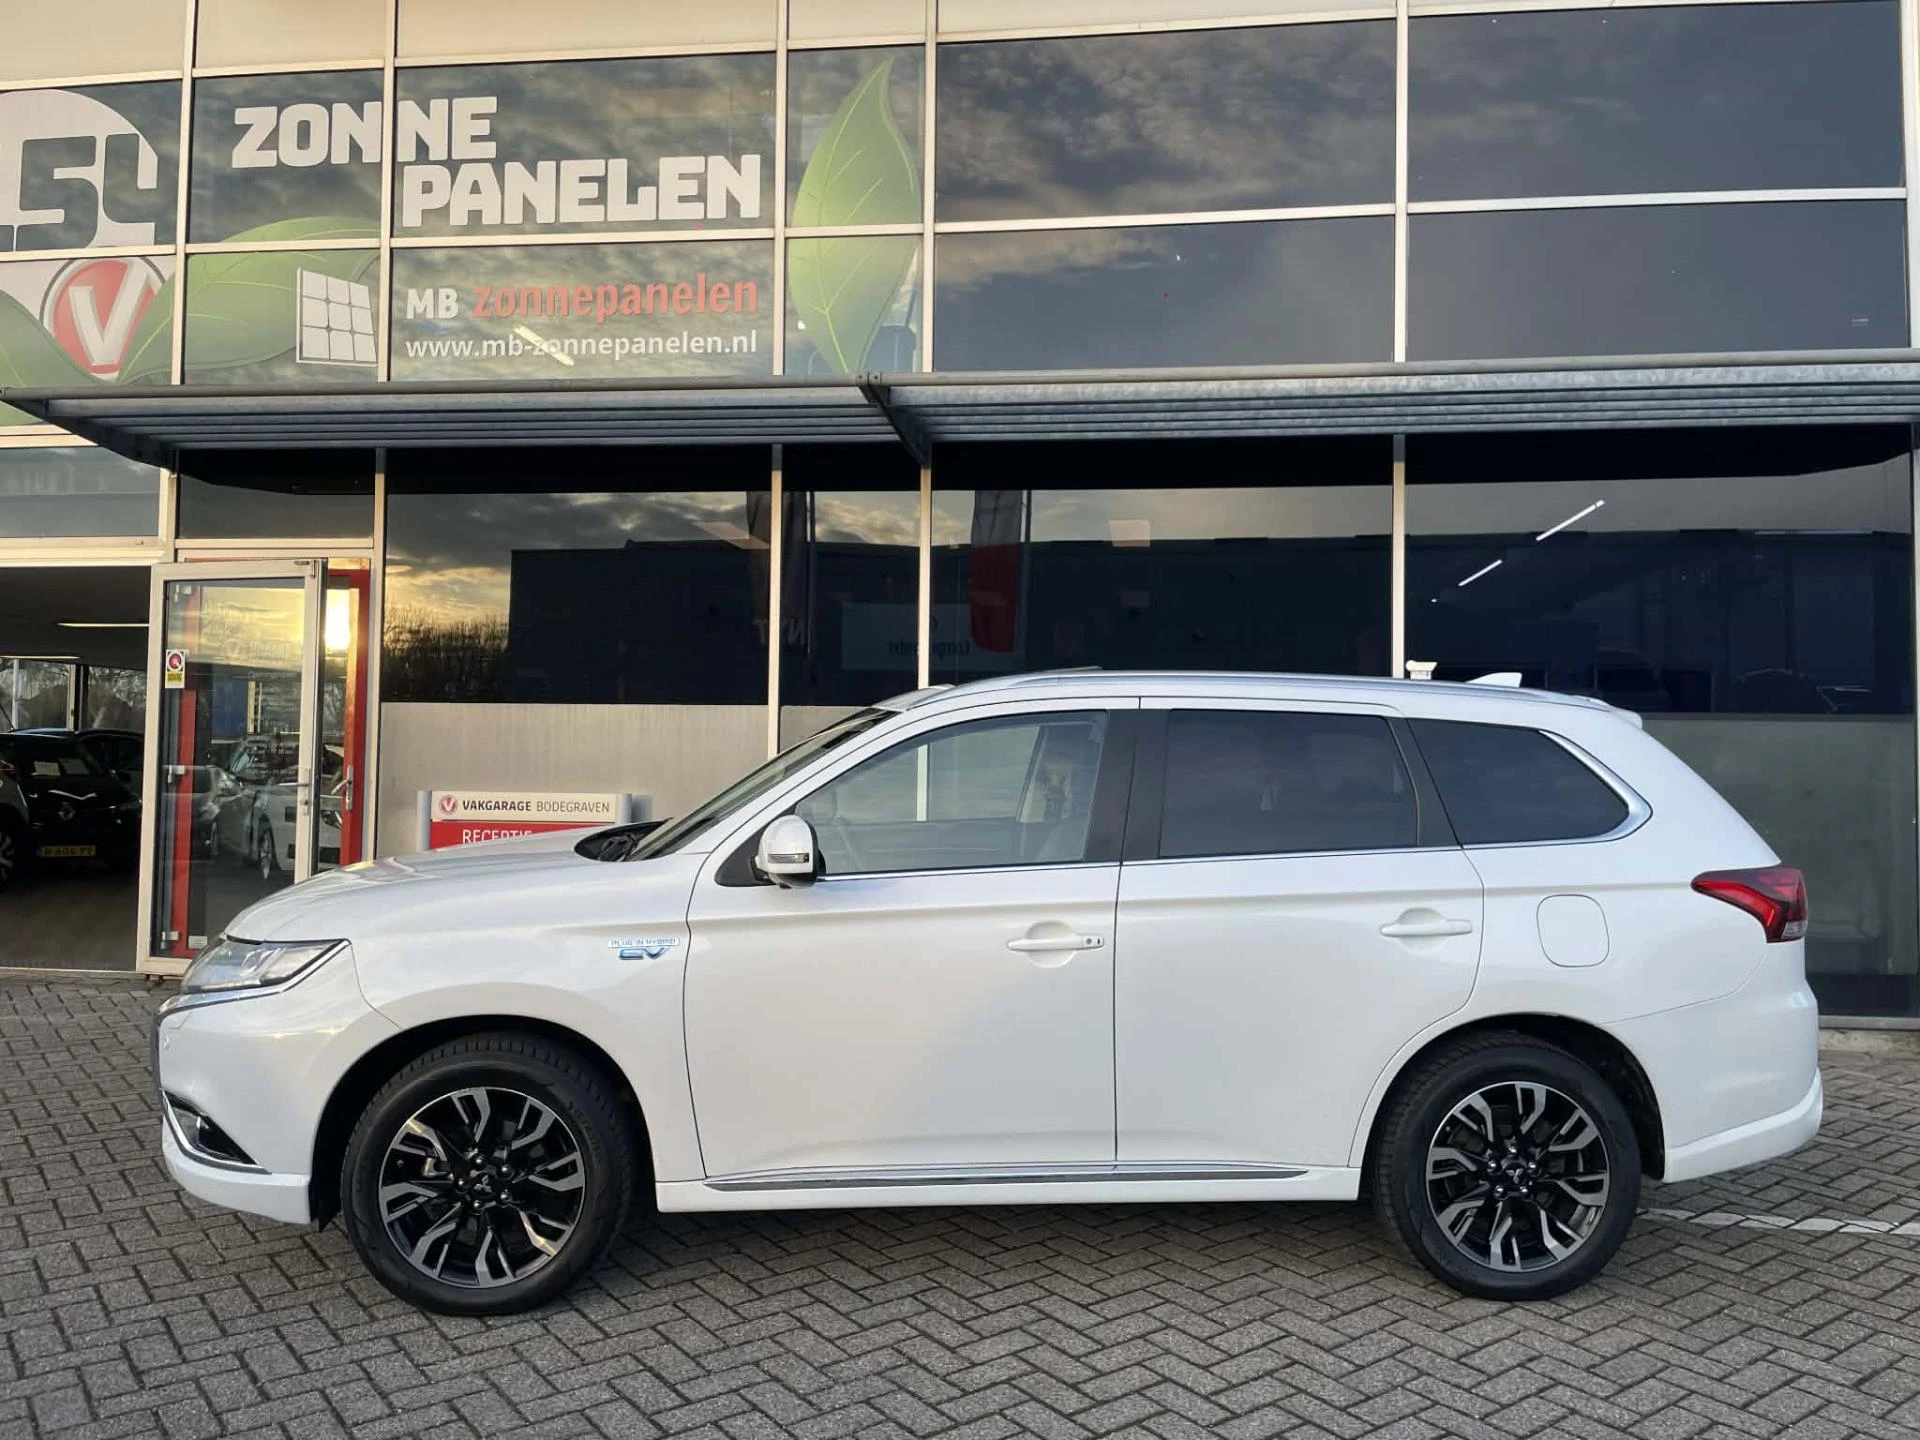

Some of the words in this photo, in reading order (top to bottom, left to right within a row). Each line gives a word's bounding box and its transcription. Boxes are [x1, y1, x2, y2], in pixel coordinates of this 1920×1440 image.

[402, 154, 761, 228] PANELEN
[406, 287, 459, 320] MB
[472, 272, 758, 323] zonnepanelen
[406, 329, 757, 360] www.mb-zonnepanelen.nl
[462, 800, 532, 812] VAKGARAGE
[536, 801, 610, 813] BODEGRAVEN
